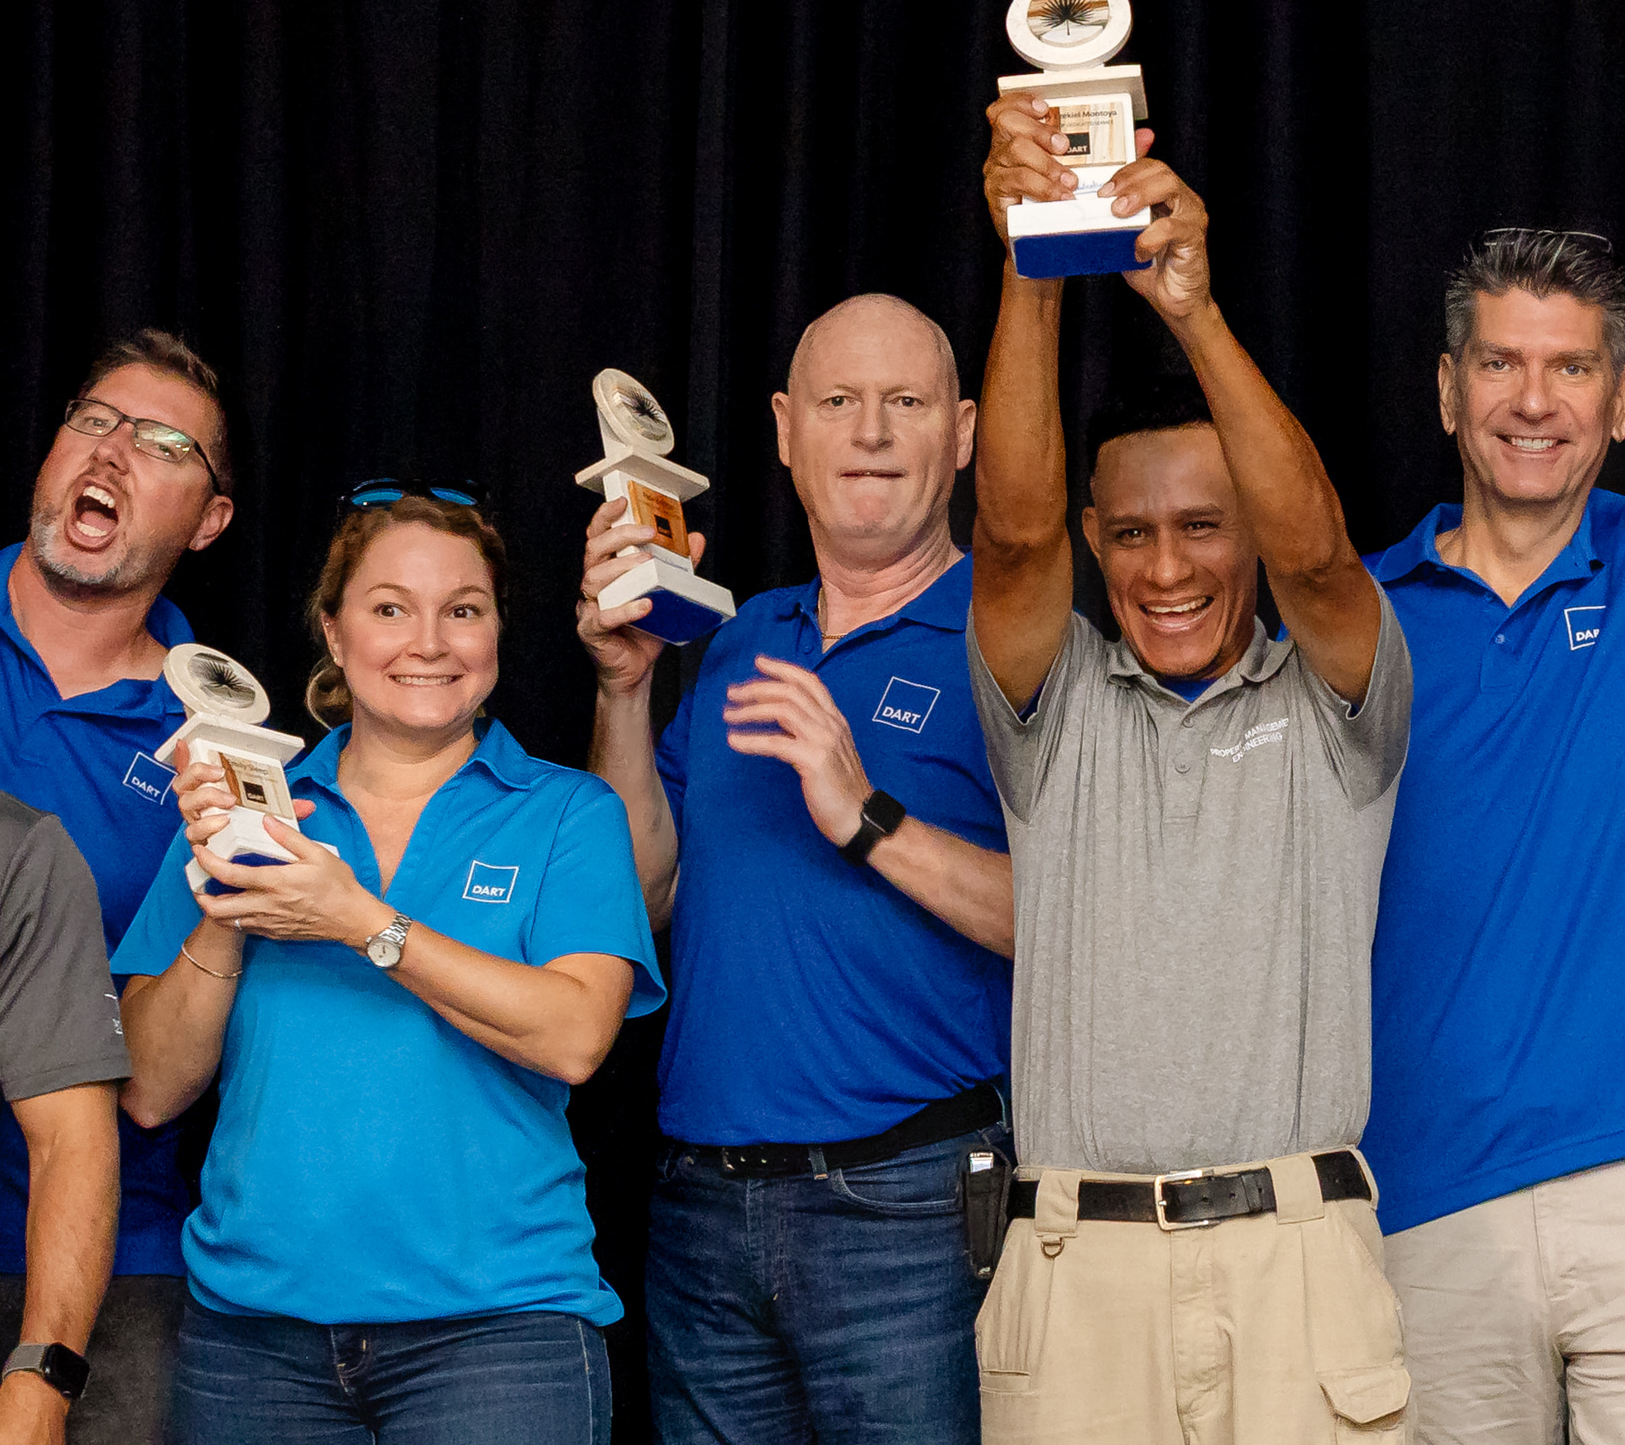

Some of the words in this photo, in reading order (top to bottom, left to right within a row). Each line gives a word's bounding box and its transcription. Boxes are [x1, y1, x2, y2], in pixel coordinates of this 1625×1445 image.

[1575, 628, 1600, 642] DAR
[881, 706, 922, 725] DART
[1244, 717, 1290, 740] MANAGEME
[131, 776, 162, 798] DART
[471, 885, 507, 897] DART
